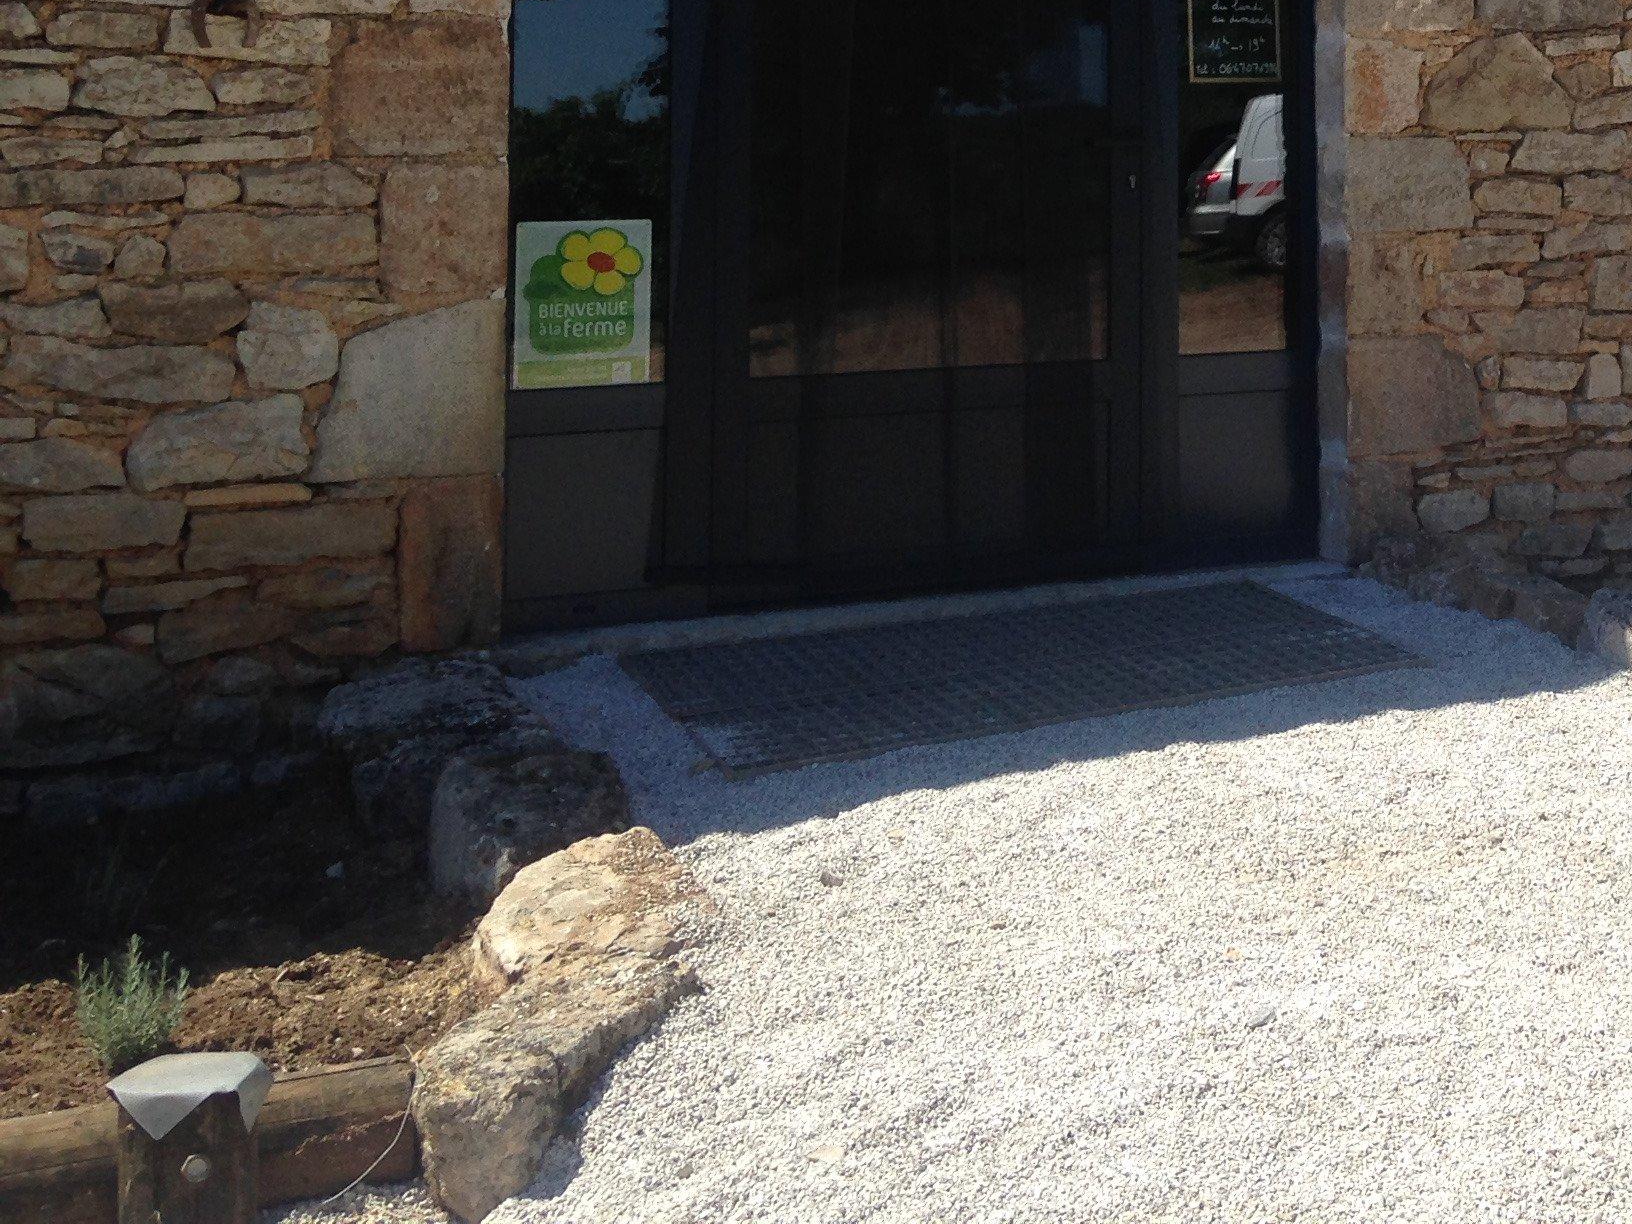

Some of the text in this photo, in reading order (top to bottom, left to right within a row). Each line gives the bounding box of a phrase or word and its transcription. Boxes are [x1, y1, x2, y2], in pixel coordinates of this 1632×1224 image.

[538, 300, 629, 319] BIENVENUE
[538, 319, 628, 338] à la ferme
